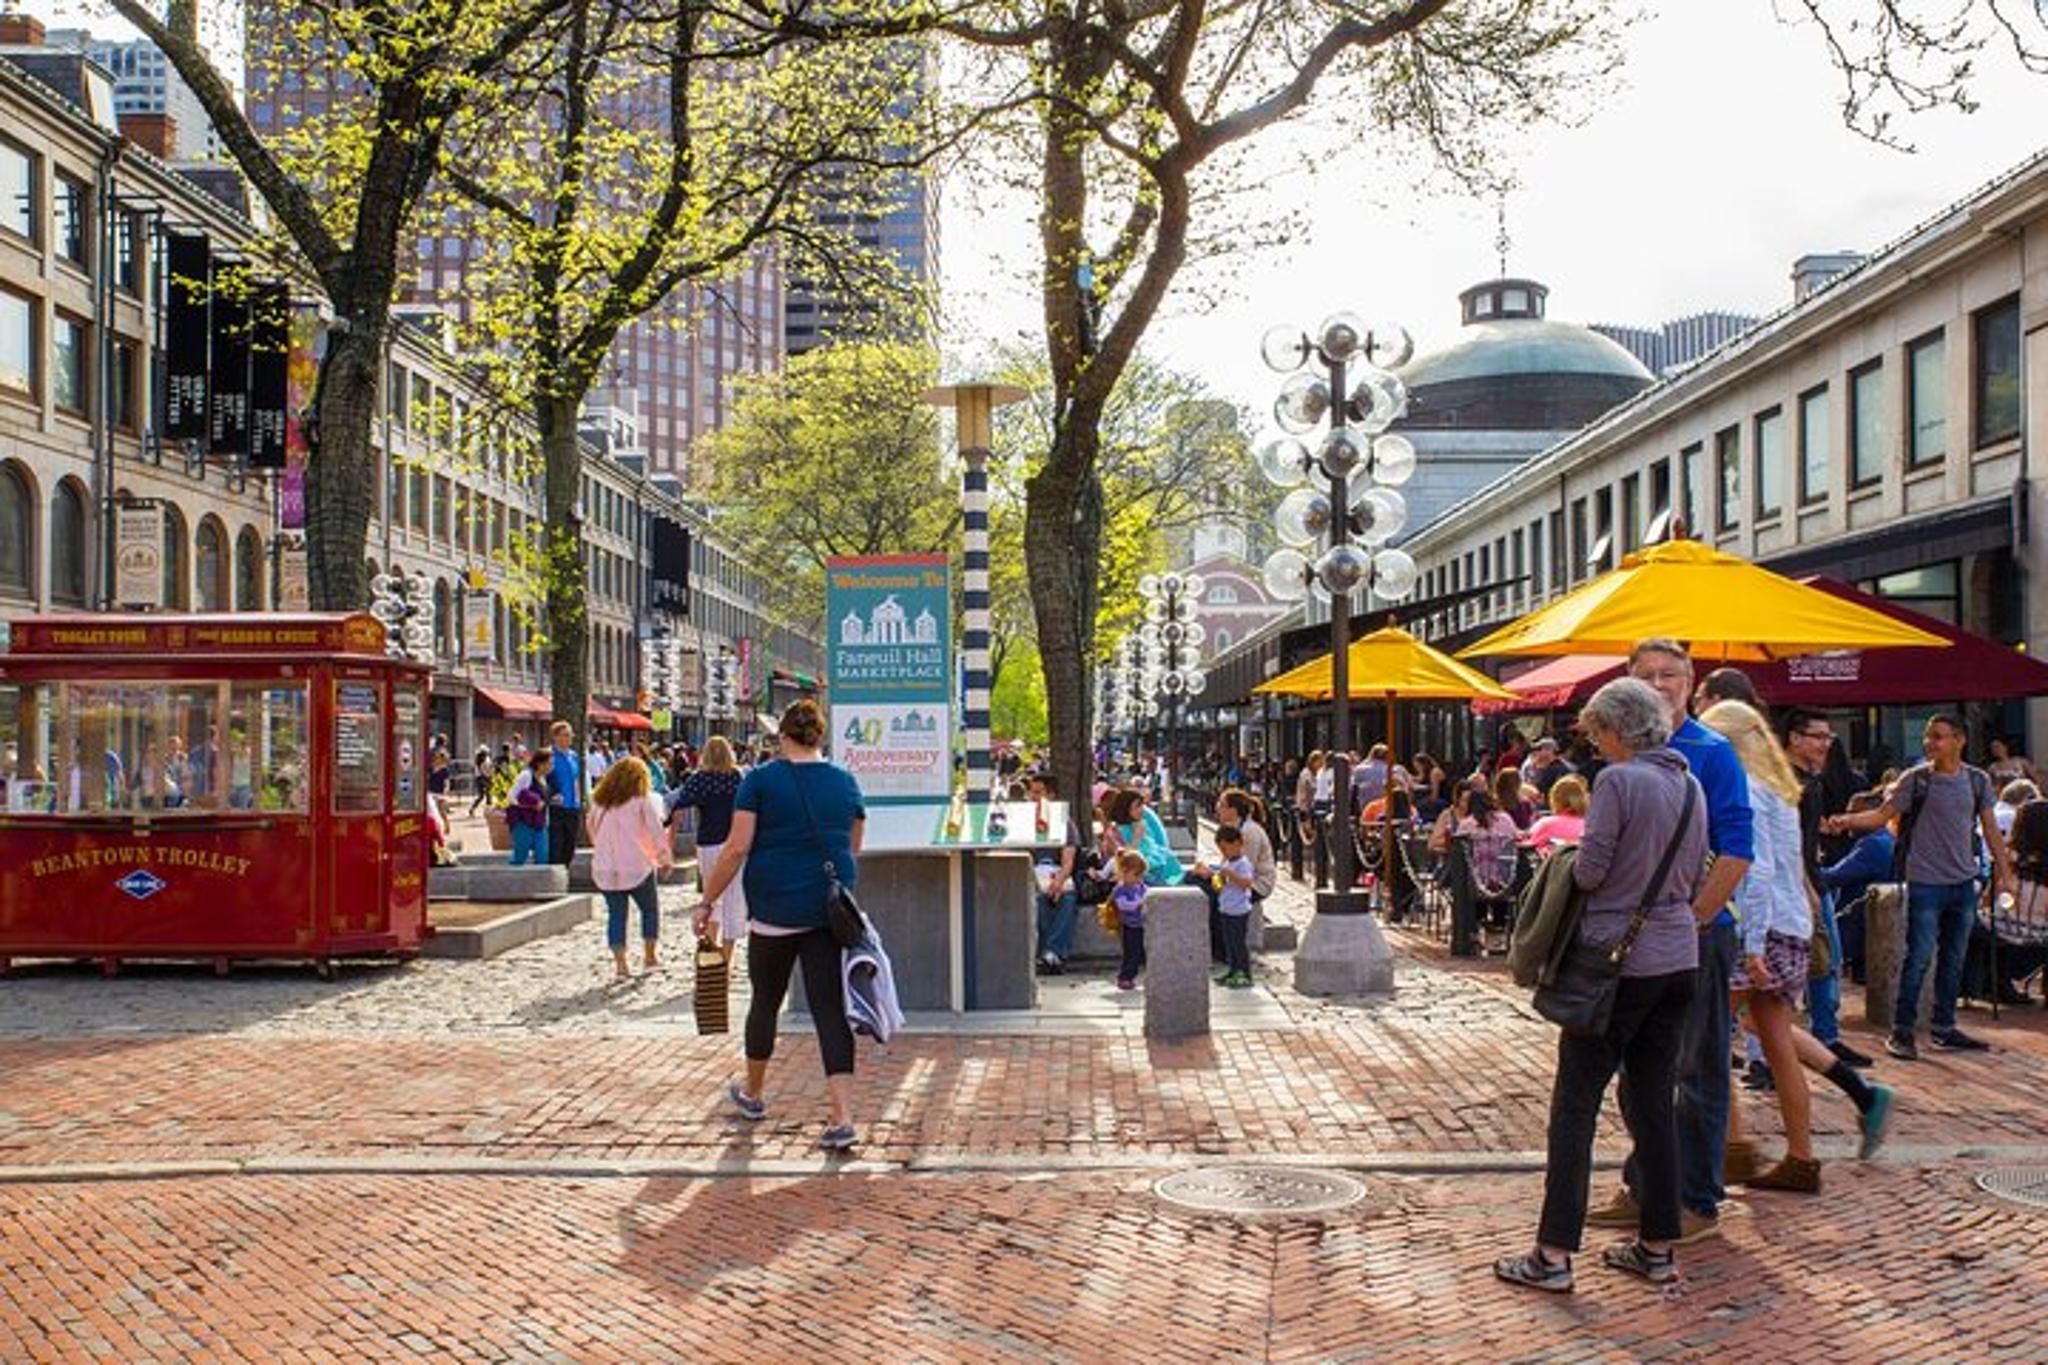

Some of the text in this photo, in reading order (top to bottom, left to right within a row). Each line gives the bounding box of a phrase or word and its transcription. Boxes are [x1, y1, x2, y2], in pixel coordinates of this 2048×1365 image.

[831, 573, 919, 588] Welcome
[836, 647, 942, 666] Faneuil Hall
[837, 665, 943, 678] MARKETPLACE
[844, 747, 941, 767] Anniversary
[31, 846, 252, 878] BEANTOWN TROLLEY
